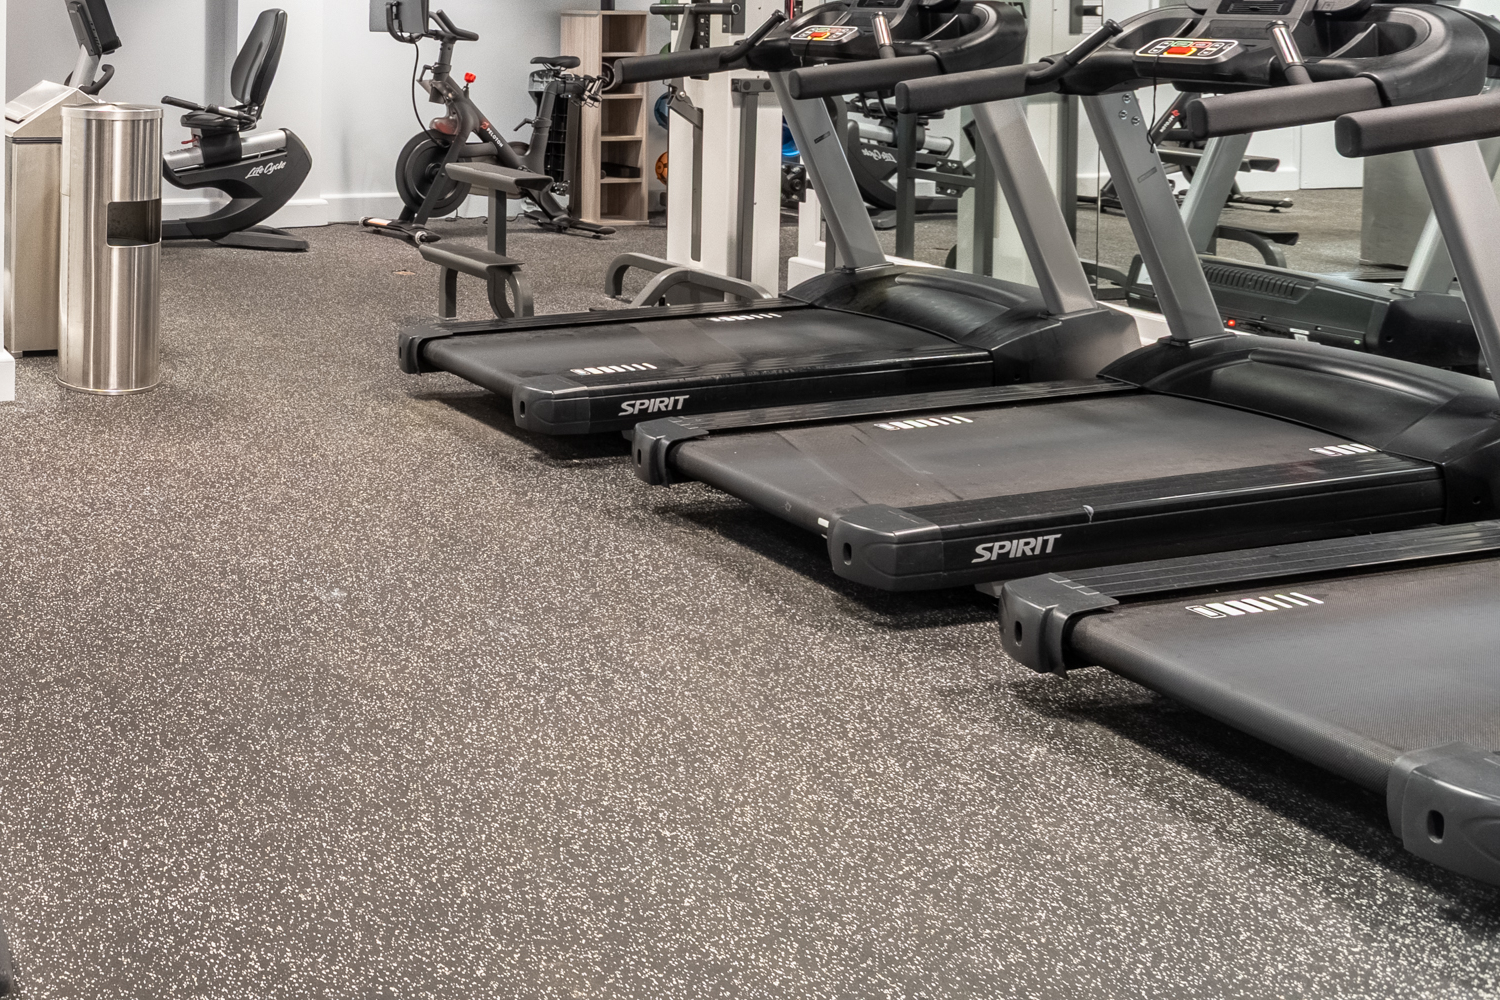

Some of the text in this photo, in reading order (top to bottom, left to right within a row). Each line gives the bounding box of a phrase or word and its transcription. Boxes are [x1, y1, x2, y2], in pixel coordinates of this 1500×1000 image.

[487, 127, 503, 147] PELOTON
[618, 395, 690, 416] SPIRIT
[971, 533, 1062, 563] SPIRIT
